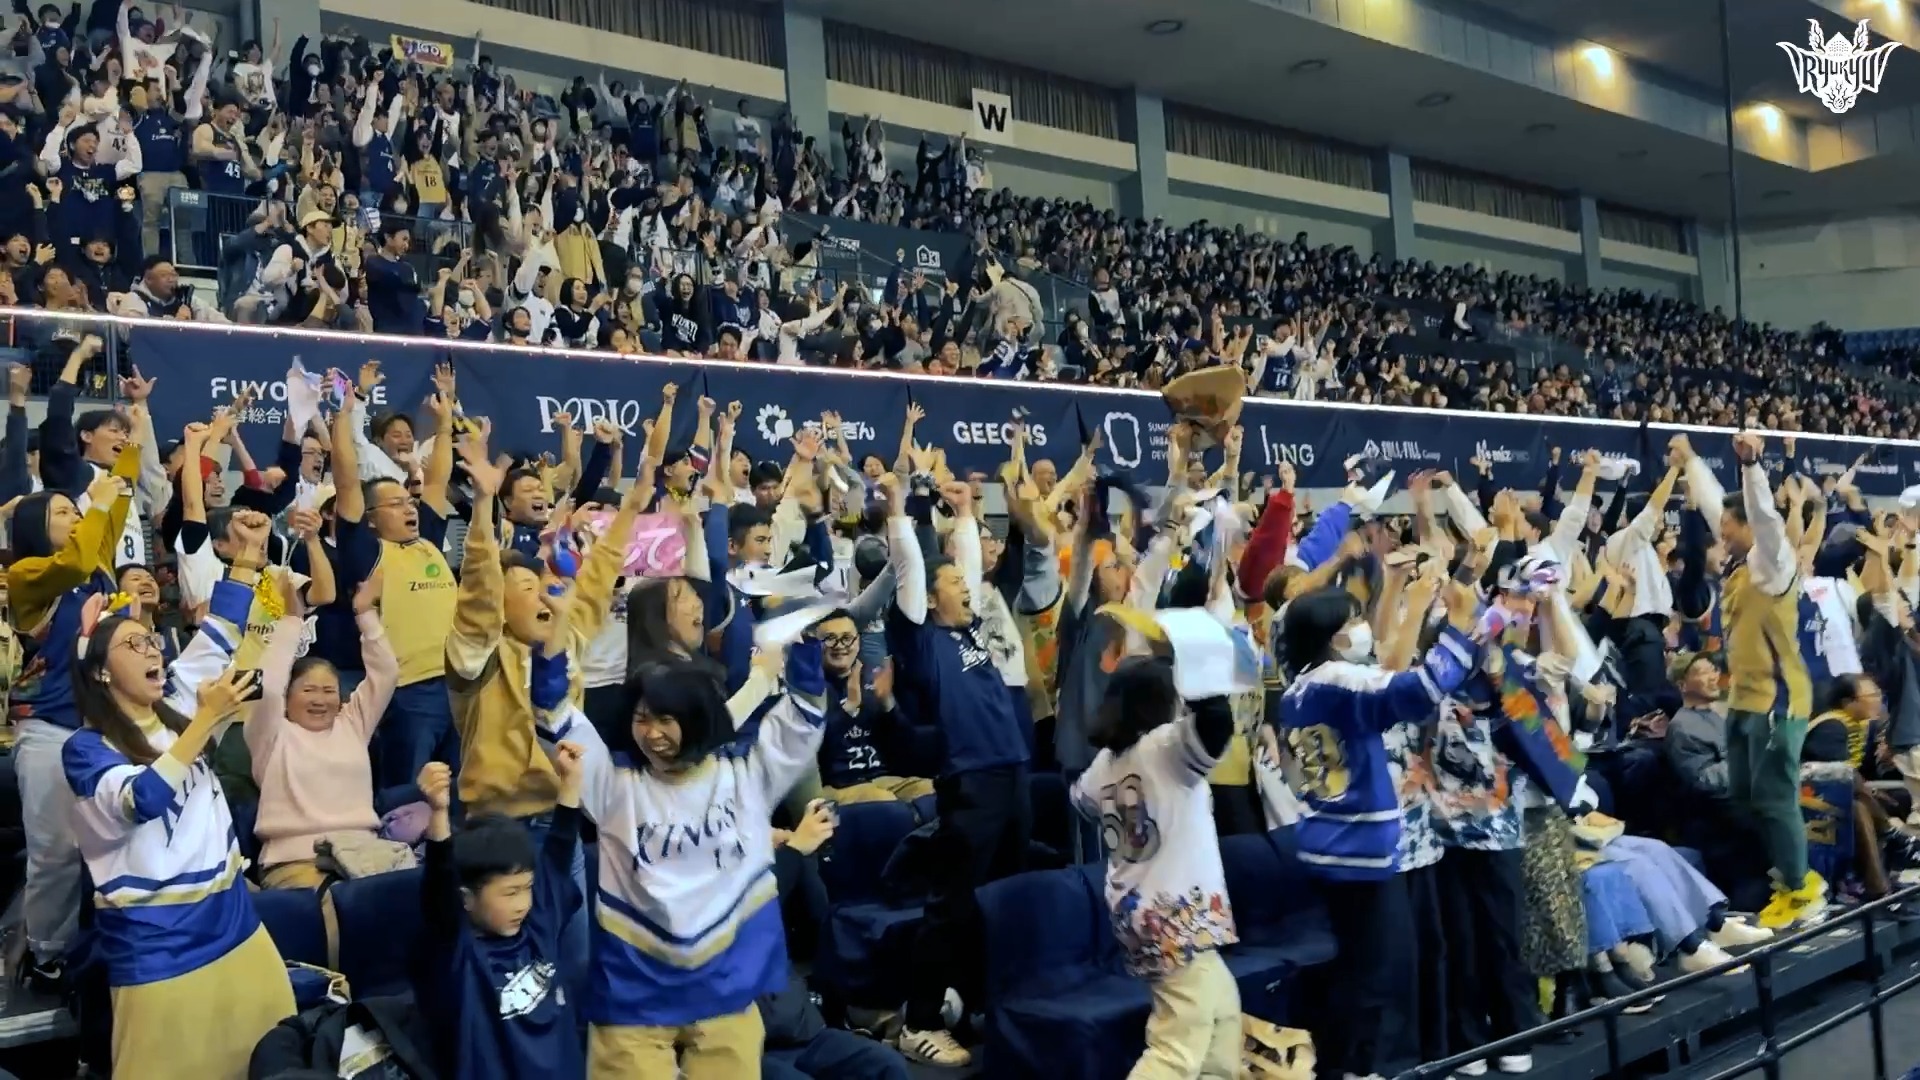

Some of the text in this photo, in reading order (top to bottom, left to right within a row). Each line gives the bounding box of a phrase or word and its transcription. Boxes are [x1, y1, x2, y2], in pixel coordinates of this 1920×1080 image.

[977, 101, 1007, 132] W
[224, 160, 241, 178] 45
[124, 534, 135, 560] 8
[846, 745, 881, 769] 22
